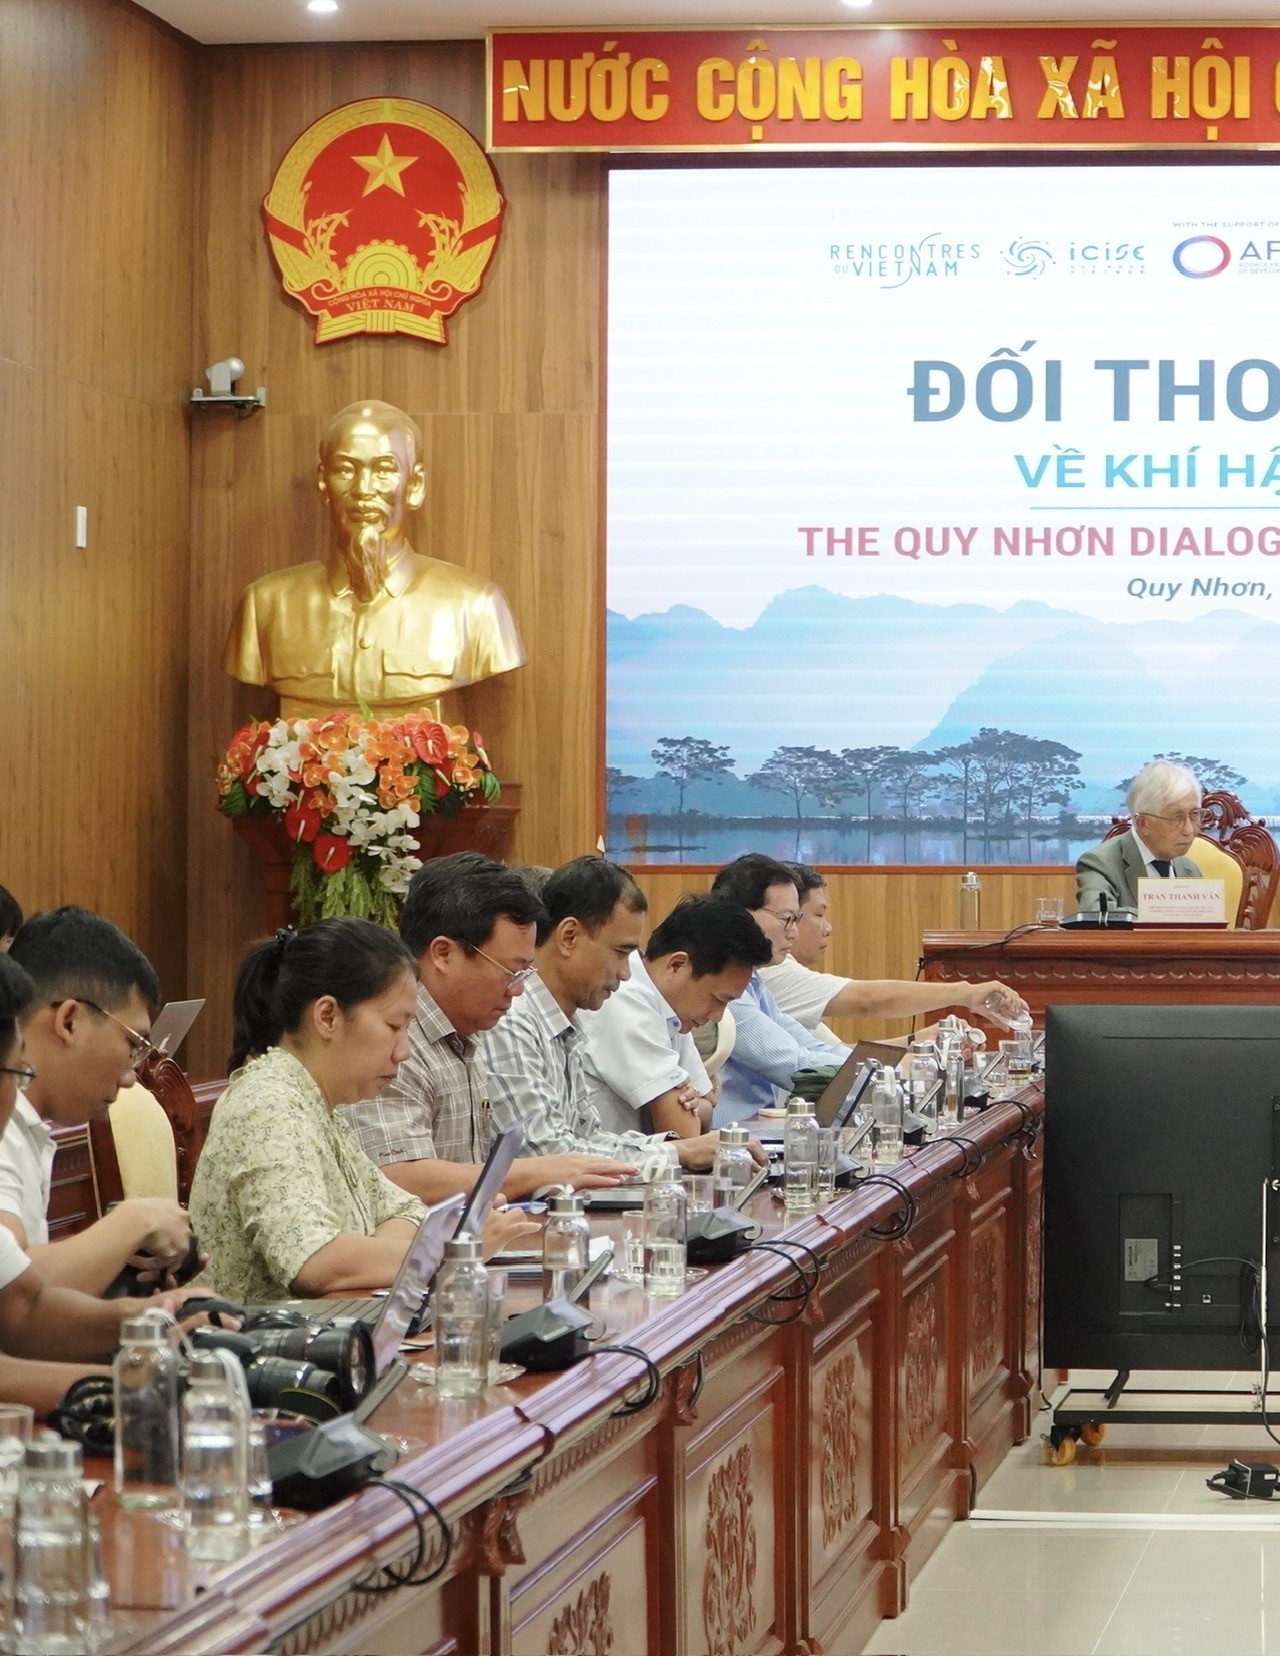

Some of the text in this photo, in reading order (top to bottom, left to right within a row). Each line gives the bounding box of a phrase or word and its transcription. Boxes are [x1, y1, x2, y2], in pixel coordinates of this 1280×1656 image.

[503, 42, 669, 121] NƯỚC
[697, 39, 864, 141] CỘNG
[888, 39, 1013, 121] HÒA
[1036, 39, 1124, 119] XÃ
[1151, 38, 1250, 141] HỘI
[830, 244, 980, 260] RENCONTRES
[852, 260, 958, 277] VIETNAM
[383, 298, 415, 312] NAM
[907, 340, 1062, 422] ĐỐI
[1014, 444, 1085, 488] VỀ
[1105, 446, 1200, 488] KHÍ
[798, 527, 880, 557] THE
[894, 526, 979, 561] QUY
[994, 525, 1114, 557] NHƠN
[1126, 577, 1182, 602] Quy
[1190, 577, 1272, 601] Nhơn,
[1169, 893, 1200, 901] THANH
